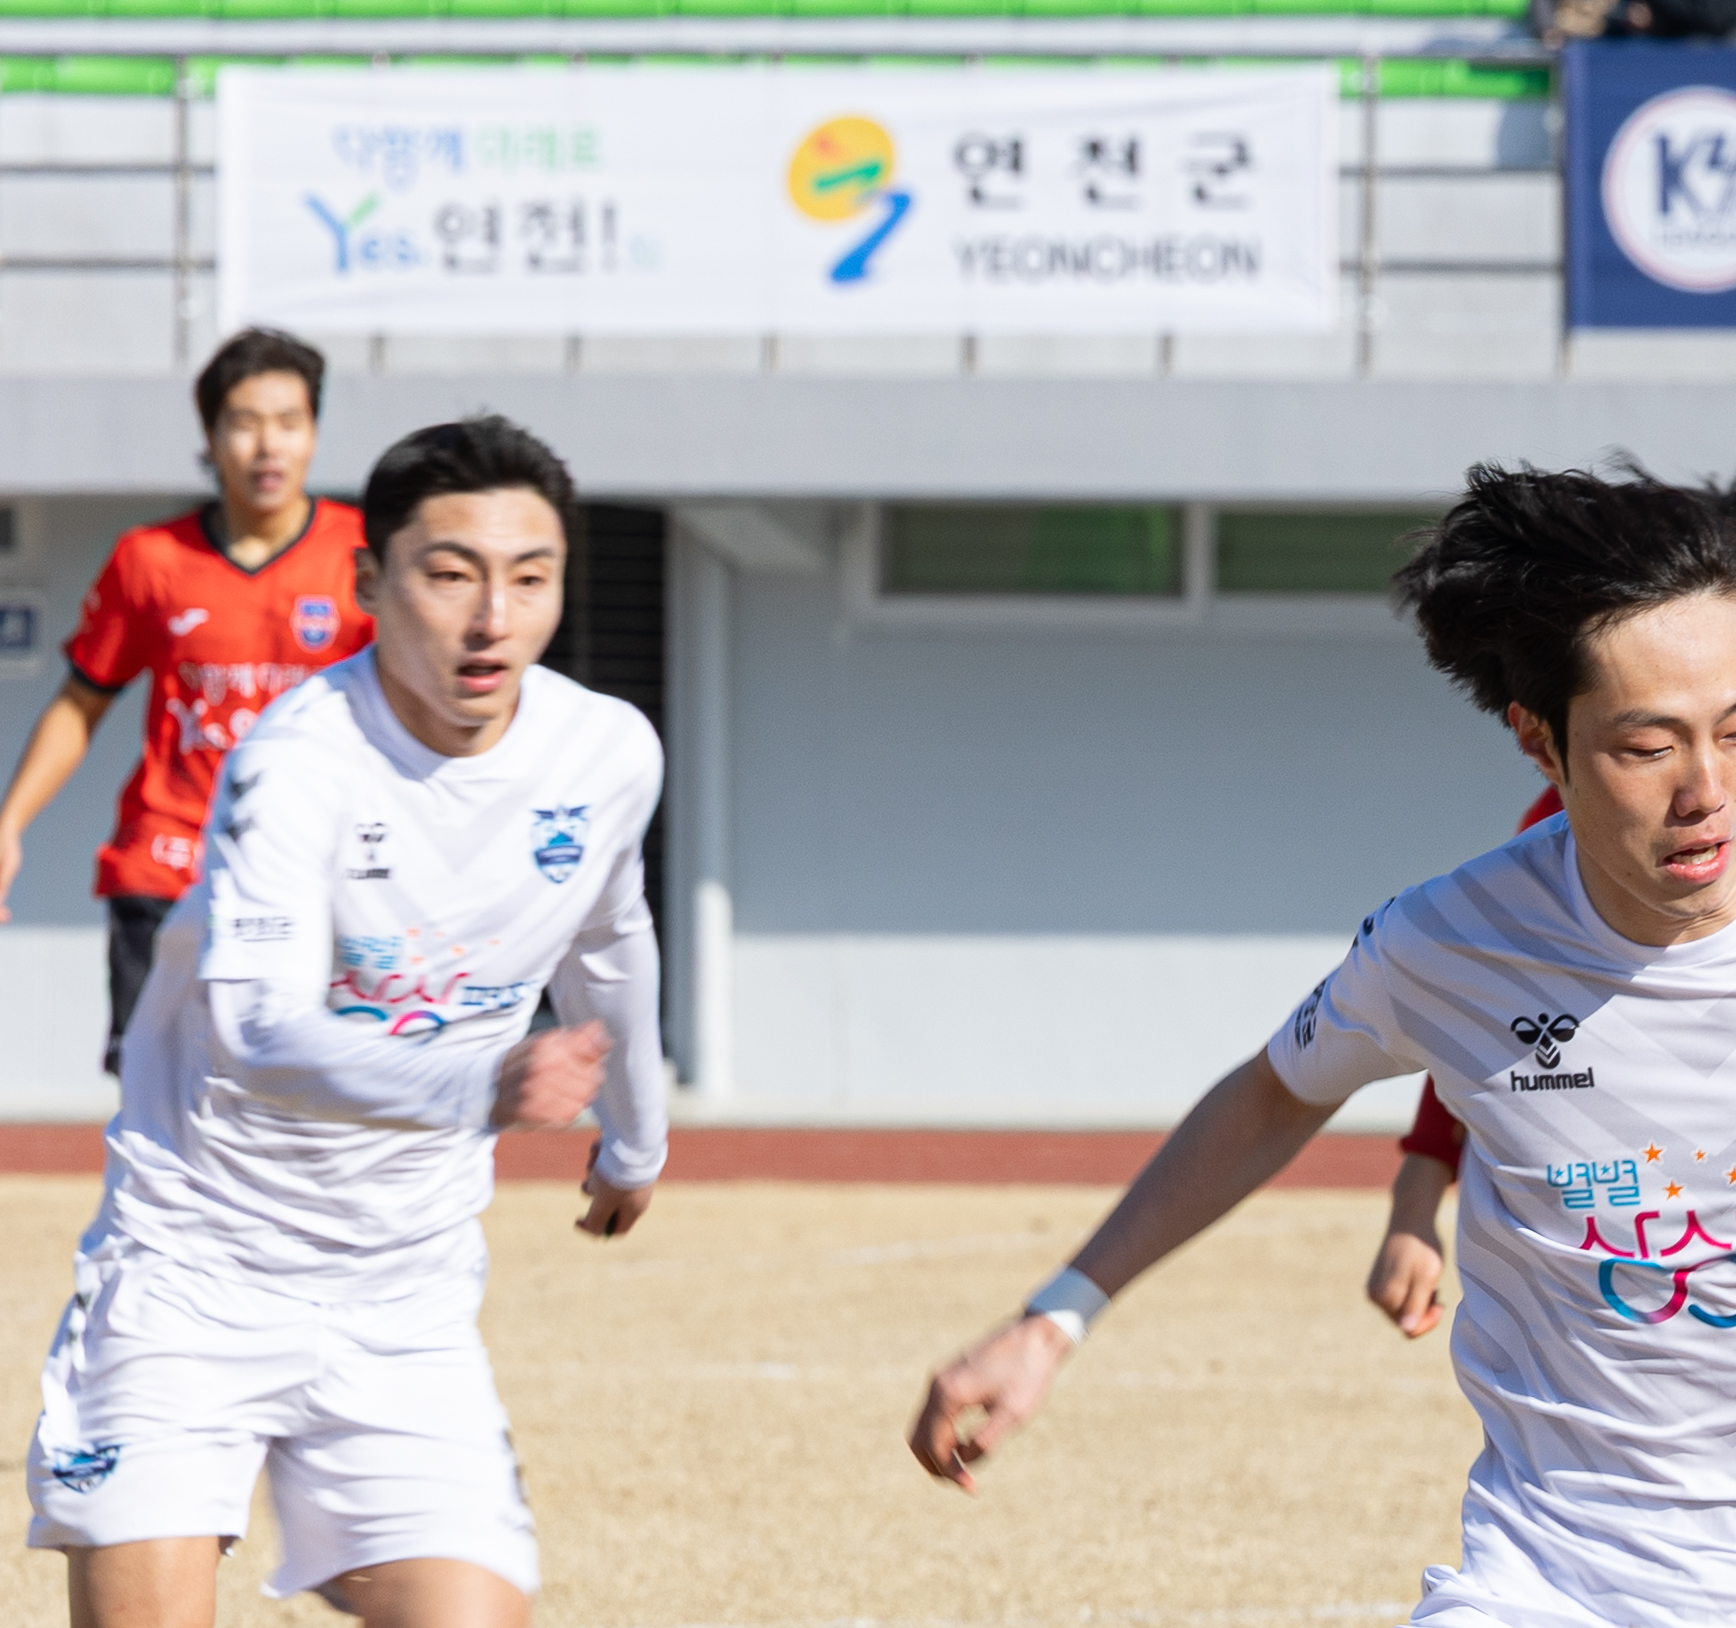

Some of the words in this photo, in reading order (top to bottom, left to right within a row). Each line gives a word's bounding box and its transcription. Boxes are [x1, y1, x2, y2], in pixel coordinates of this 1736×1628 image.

[954, 130, 1252, 212] 연천군
[433, 195, 619, 275] 연천!
[950, 236, 1262, 282] YEONCHEON
[1510, 1066, 1595, 1092] hummel
[1546, 1159, 1642, 1209] 별별
